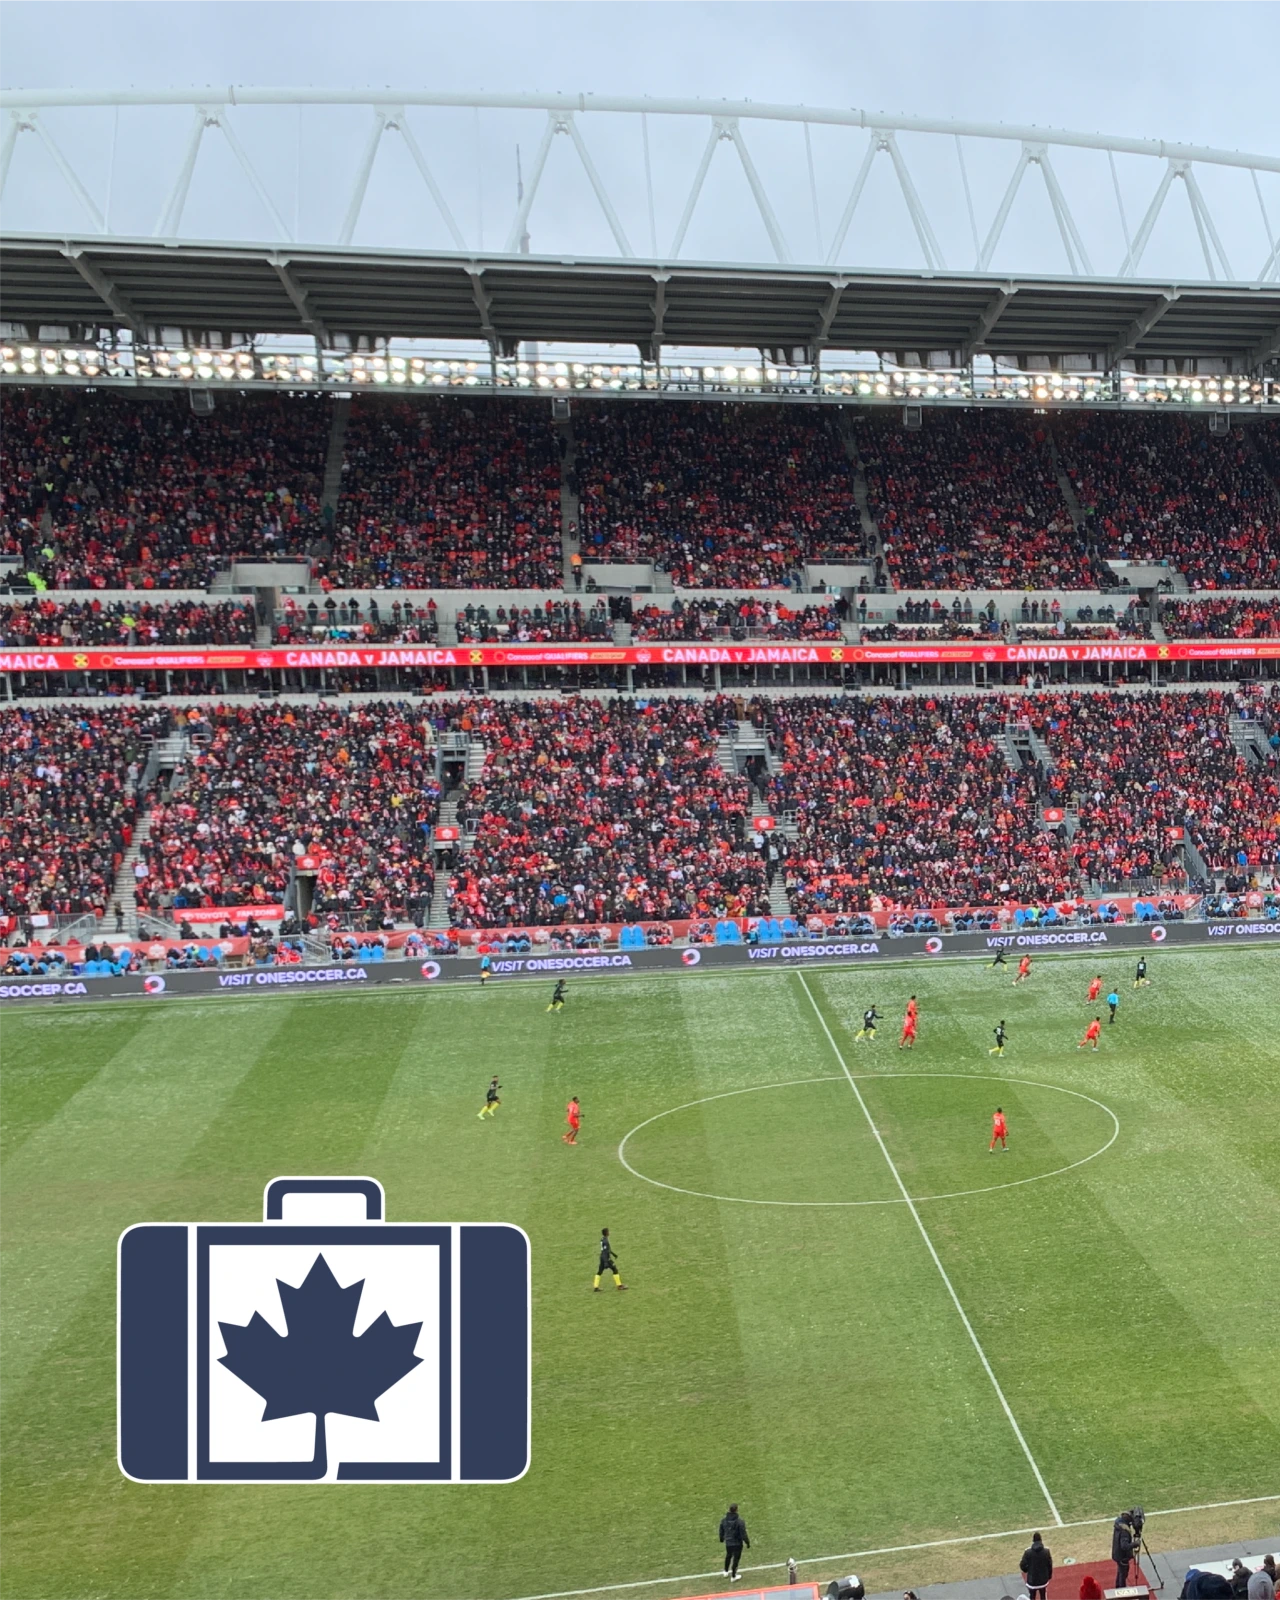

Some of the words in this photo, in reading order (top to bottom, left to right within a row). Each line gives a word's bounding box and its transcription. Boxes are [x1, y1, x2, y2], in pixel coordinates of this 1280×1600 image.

[286, 652, 361, 666] CANADA
[365, 654, 374, 665] v
[378, 650, 457, 665] JAMAICA
[543, 652, 589, 661] QUALIFIERS
[663, 648, 731, 662] CANADA
[735, 652, 744, 662] v
[748, 648, 820, 662] JAMAICA
[899, 650, 939, 659] QUALIFIERS
[1007, 647, 1069, 660] CANADA
[1071, 649, 1080, 660] v
[1082, 646, 1147, 660] JAMAICA
[1219, 648, 1256, 656] QUALIFIERS
[155, 656, 205, 665] QUALIFIERS
[1207, 925, 1234, 936] VISIT
[986, 936, 1016, 948] VISIT
[1016, 931, 1108, 946] ONESOCCER.CA
[748, 947, 780, 959] VISIT
[781, 942, 880, 958] ONESOCCER.CA
[491, 960, 525, 973] VISIT
[527, 954, 633, 971] ONESOCCER.CA
[219, 974, 254, 987] VISIT
[256, 968, 368, 984] ONESOCCER.CA
